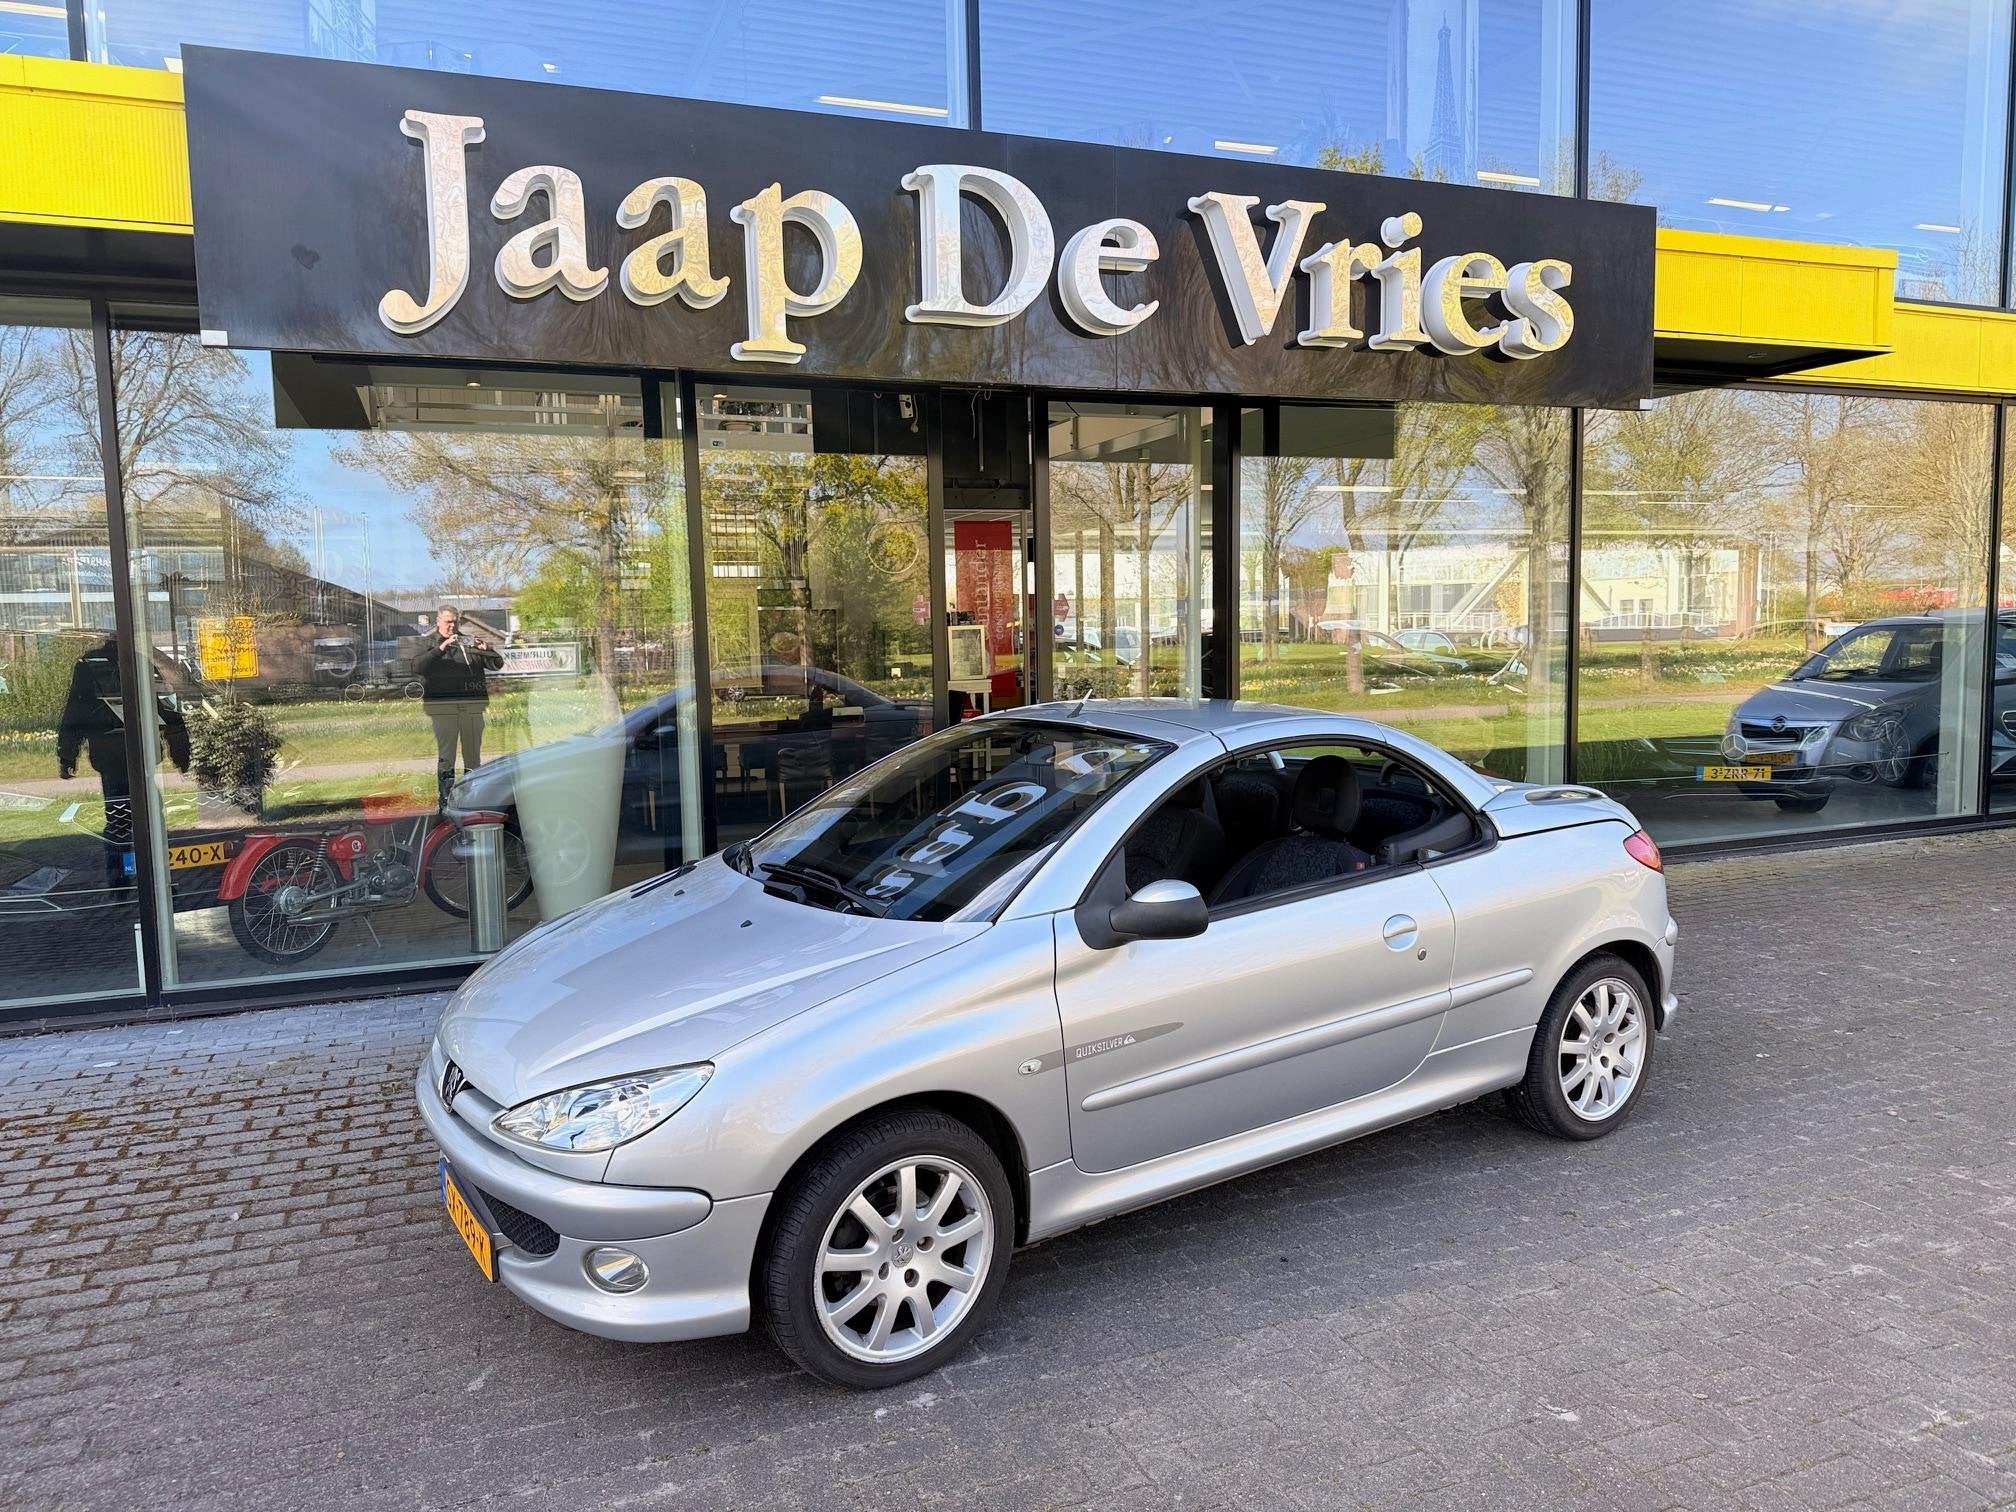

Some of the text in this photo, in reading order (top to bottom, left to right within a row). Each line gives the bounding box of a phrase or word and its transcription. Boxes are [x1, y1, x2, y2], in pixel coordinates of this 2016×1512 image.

[378, 109, 1576, 364] Jaap De Vries
[1076, 1037, 1123, 1058] QUIKSILVER
